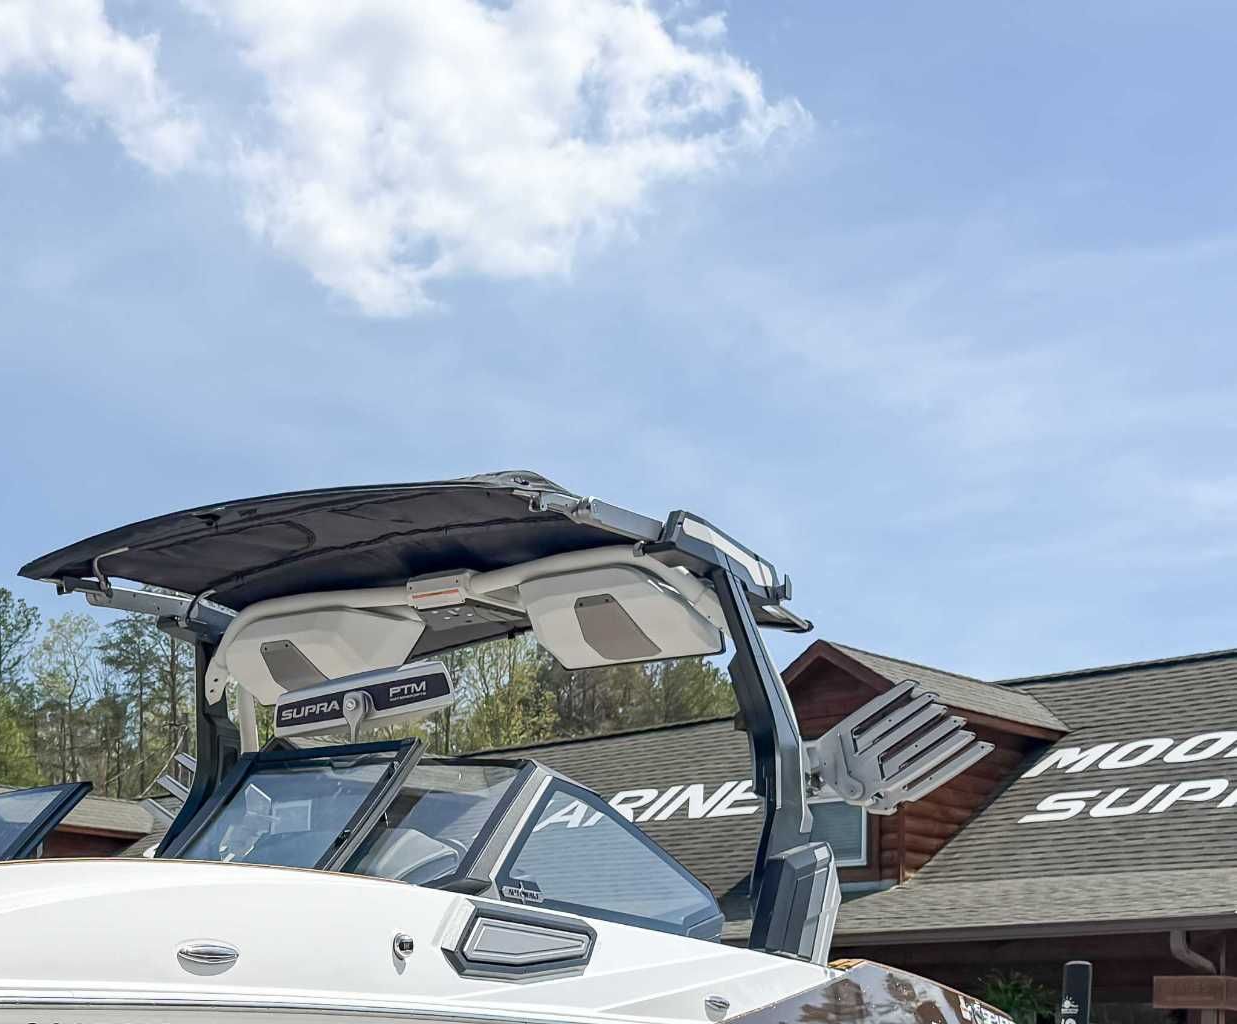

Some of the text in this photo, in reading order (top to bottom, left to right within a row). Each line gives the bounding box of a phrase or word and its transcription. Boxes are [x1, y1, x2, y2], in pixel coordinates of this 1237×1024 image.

[280, 700, 340, 721] SUPRA
[389, 681, 426, 697] PTM
[1020, 731, 1237, 778] MOO
[530, 780, 760, 833] ARINE
[1017, 779, 1237, 823] SUP
